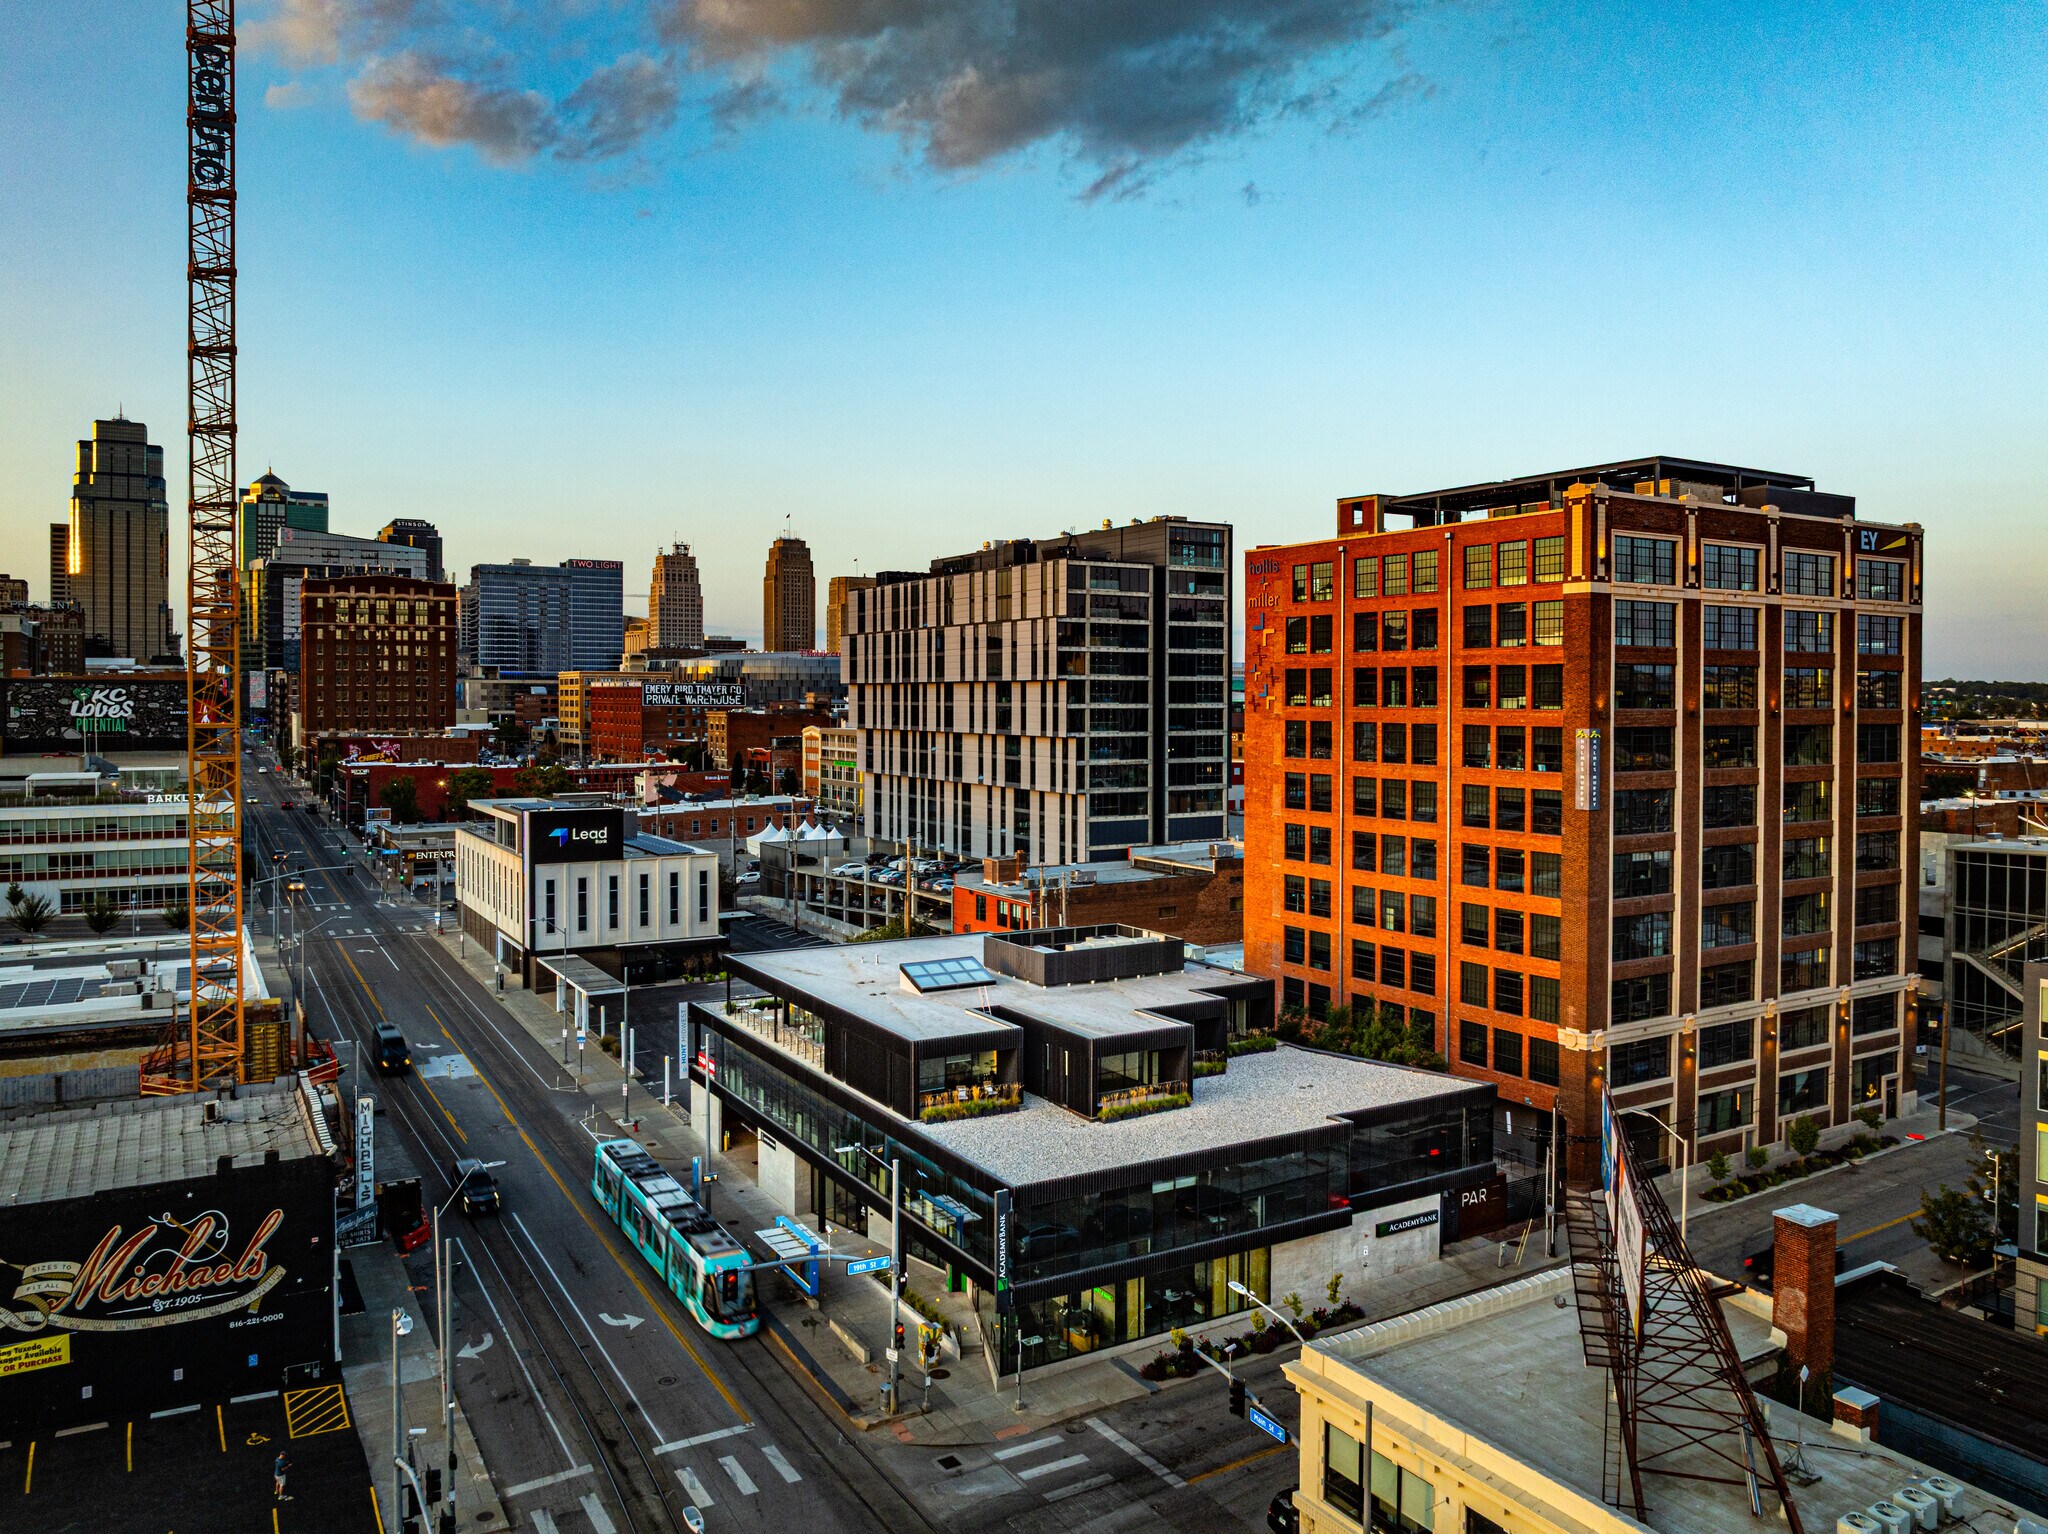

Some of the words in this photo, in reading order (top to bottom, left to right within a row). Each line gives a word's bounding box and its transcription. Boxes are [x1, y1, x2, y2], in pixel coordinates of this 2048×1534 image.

[1861, 530, 1878, 550] EY
[572, 560, 593, 568] TWO
[595, 561, 621, 569] LIGHT
[1249, 559, 1279, 575] hollis
[10, 600, 71, 609] PRESIDENT
[1249, 592, 1279, 608] miller
[645, 684, 671, 694] EMERY
[91, 688, 127, 705] KC
[76, 718, 126, 732] POTENTIAL
[358, 752, 385, 762] CHIEFS
[572, 826, 608, 840] Lead
[32, 1264, 58, 1272] SIZES
[853, 1263, 866, 1272] 19th
[229, 1312, 284, 1329] 816-221-0000
[14, 1343, 42, 1354] Tuxedo
[24, 1346, 62, 1360] Available
[3, 1364, 16, 1373] OR
[18, 1355, 63, 1370] PURCHASE
